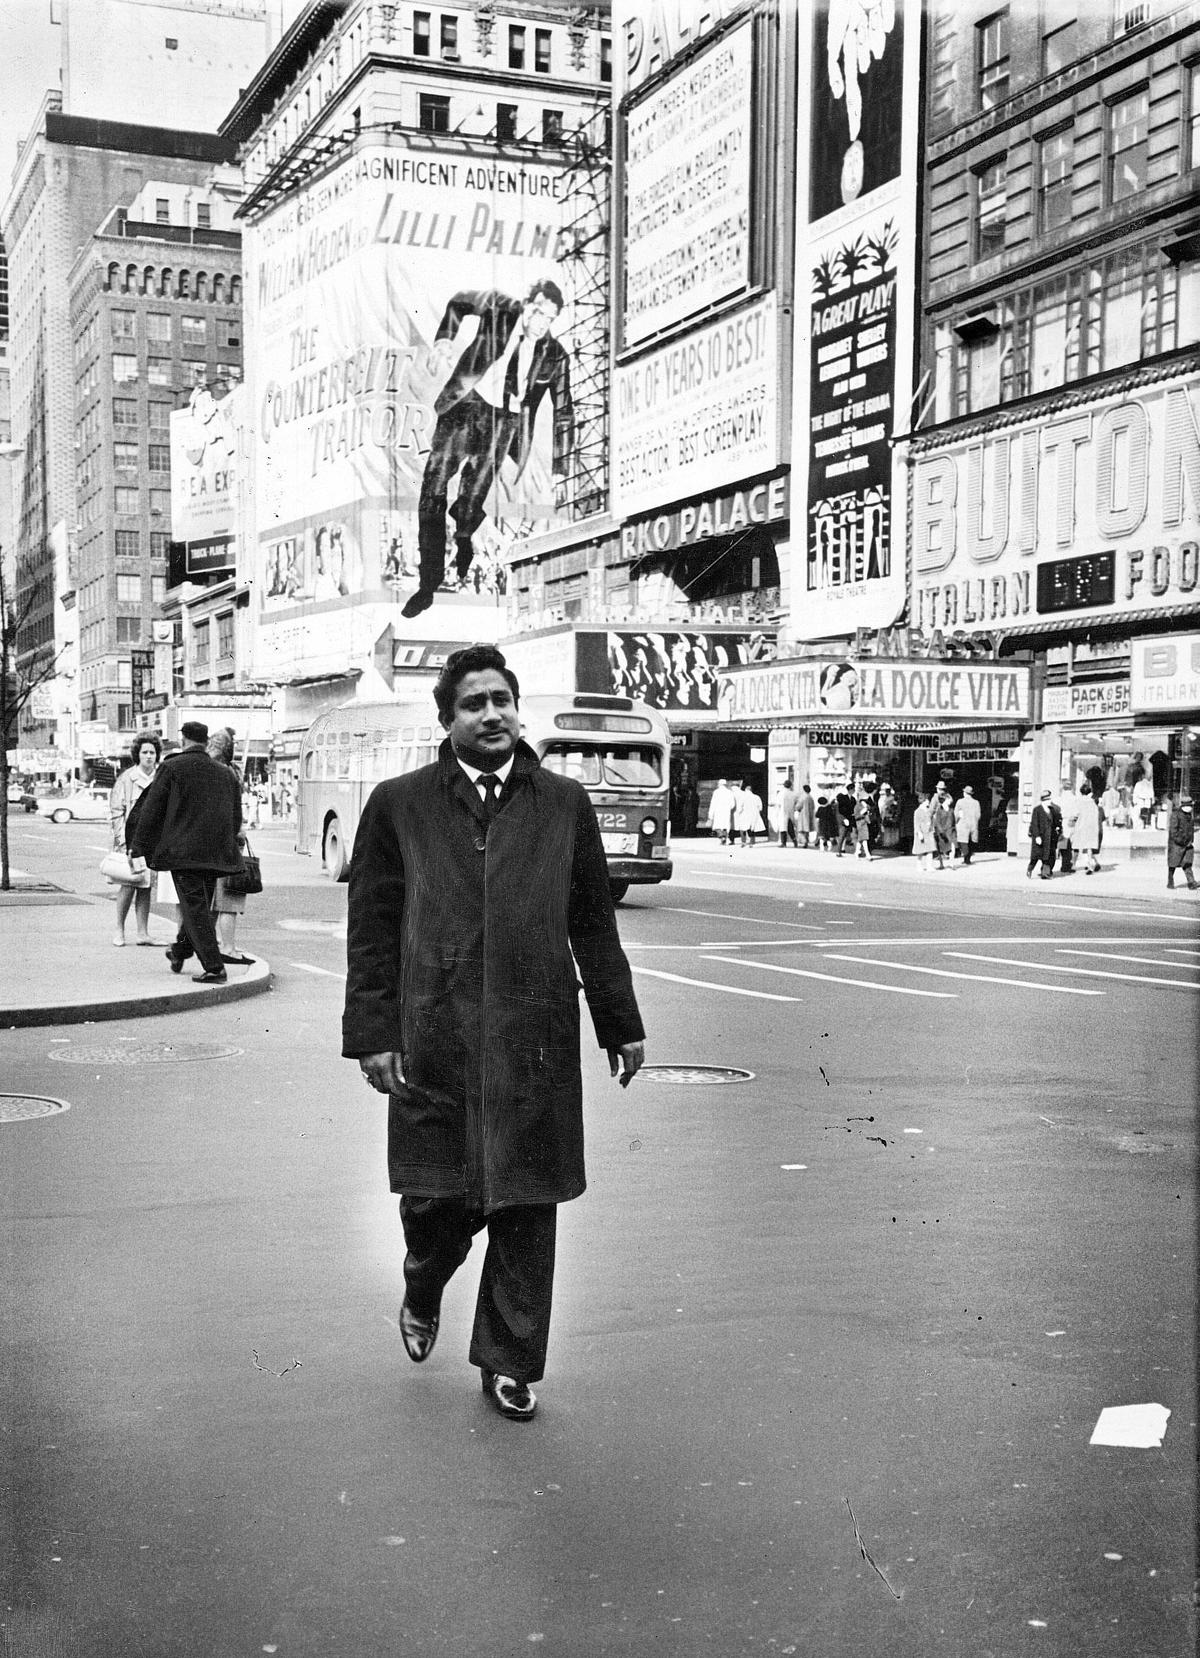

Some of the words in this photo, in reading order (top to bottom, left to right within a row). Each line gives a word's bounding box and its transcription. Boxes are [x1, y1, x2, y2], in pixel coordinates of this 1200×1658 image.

[372, 192, 457, 249] LILLI
[822, 295, 859, 333] GREAT
[290, 323, 318, 371] THE
[645, 360, 660, 408] OF
[664, 339, 703, 400] YEARS
[708, 331, 722, 381] 10
[311, 402, 432, 478] TRAITOR
[641, 443, 671, 477] ACTOR
[678, 431, 699, 466] BEST
[621, 515, 671, 559] RKO
[680, 478, 785, 546] PALACE
[919, 570, 1030, 628] ITALIAN
[856, 626, 1005, 659] EMBASSY
[788, 670, 817, 710] VITA
[859, 669, 886, 708] LA
[891, 670, 961, 710] DOLCE
[967, 673, 1021, 711] VITA
[1072, 687, 1104, 709] PACK
[1077, 704, 1097, 715] GIFT
[1100, 701, 1129, 713] SHOP
[808, 731, 868, 746] EXCLUSIVE
[871, 733, 889, 747] N.Y.
[892, 734, 940, 748] SHOWING
